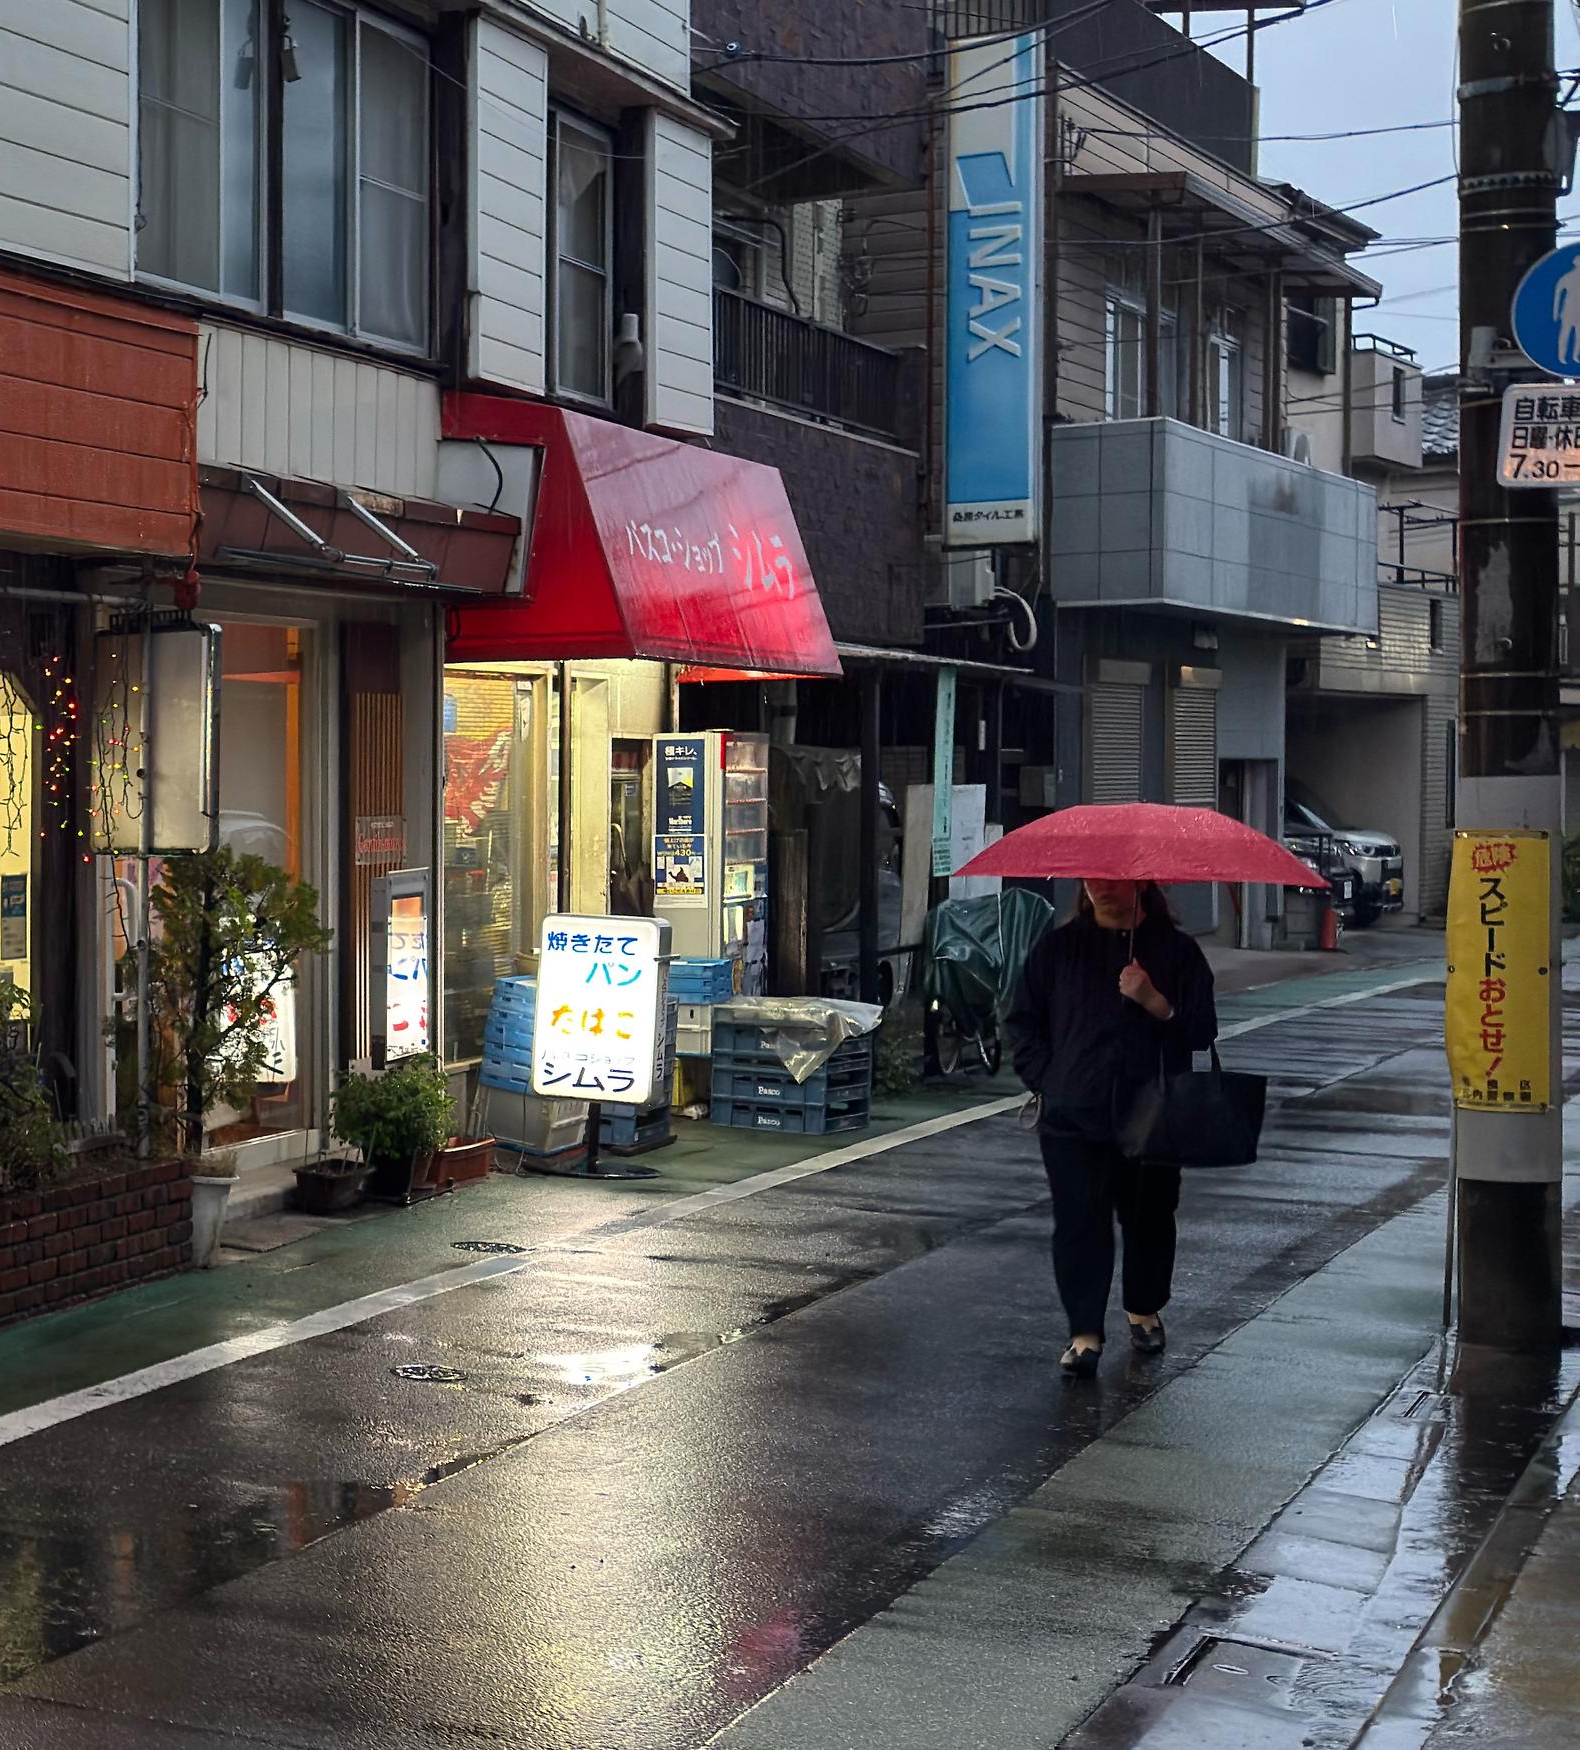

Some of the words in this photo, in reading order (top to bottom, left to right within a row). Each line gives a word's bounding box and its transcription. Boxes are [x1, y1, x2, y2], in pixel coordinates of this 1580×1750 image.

[967, 200, 1022, 362] INAX
[728, 523, 795, 600] シムラ
[547, 931, 639, 956] 焼きたて
[585, 961, 642, 986] パン
[542, 1062, 635, 1093] シムラ
[758, 1086, 781, 1096] Pasco
